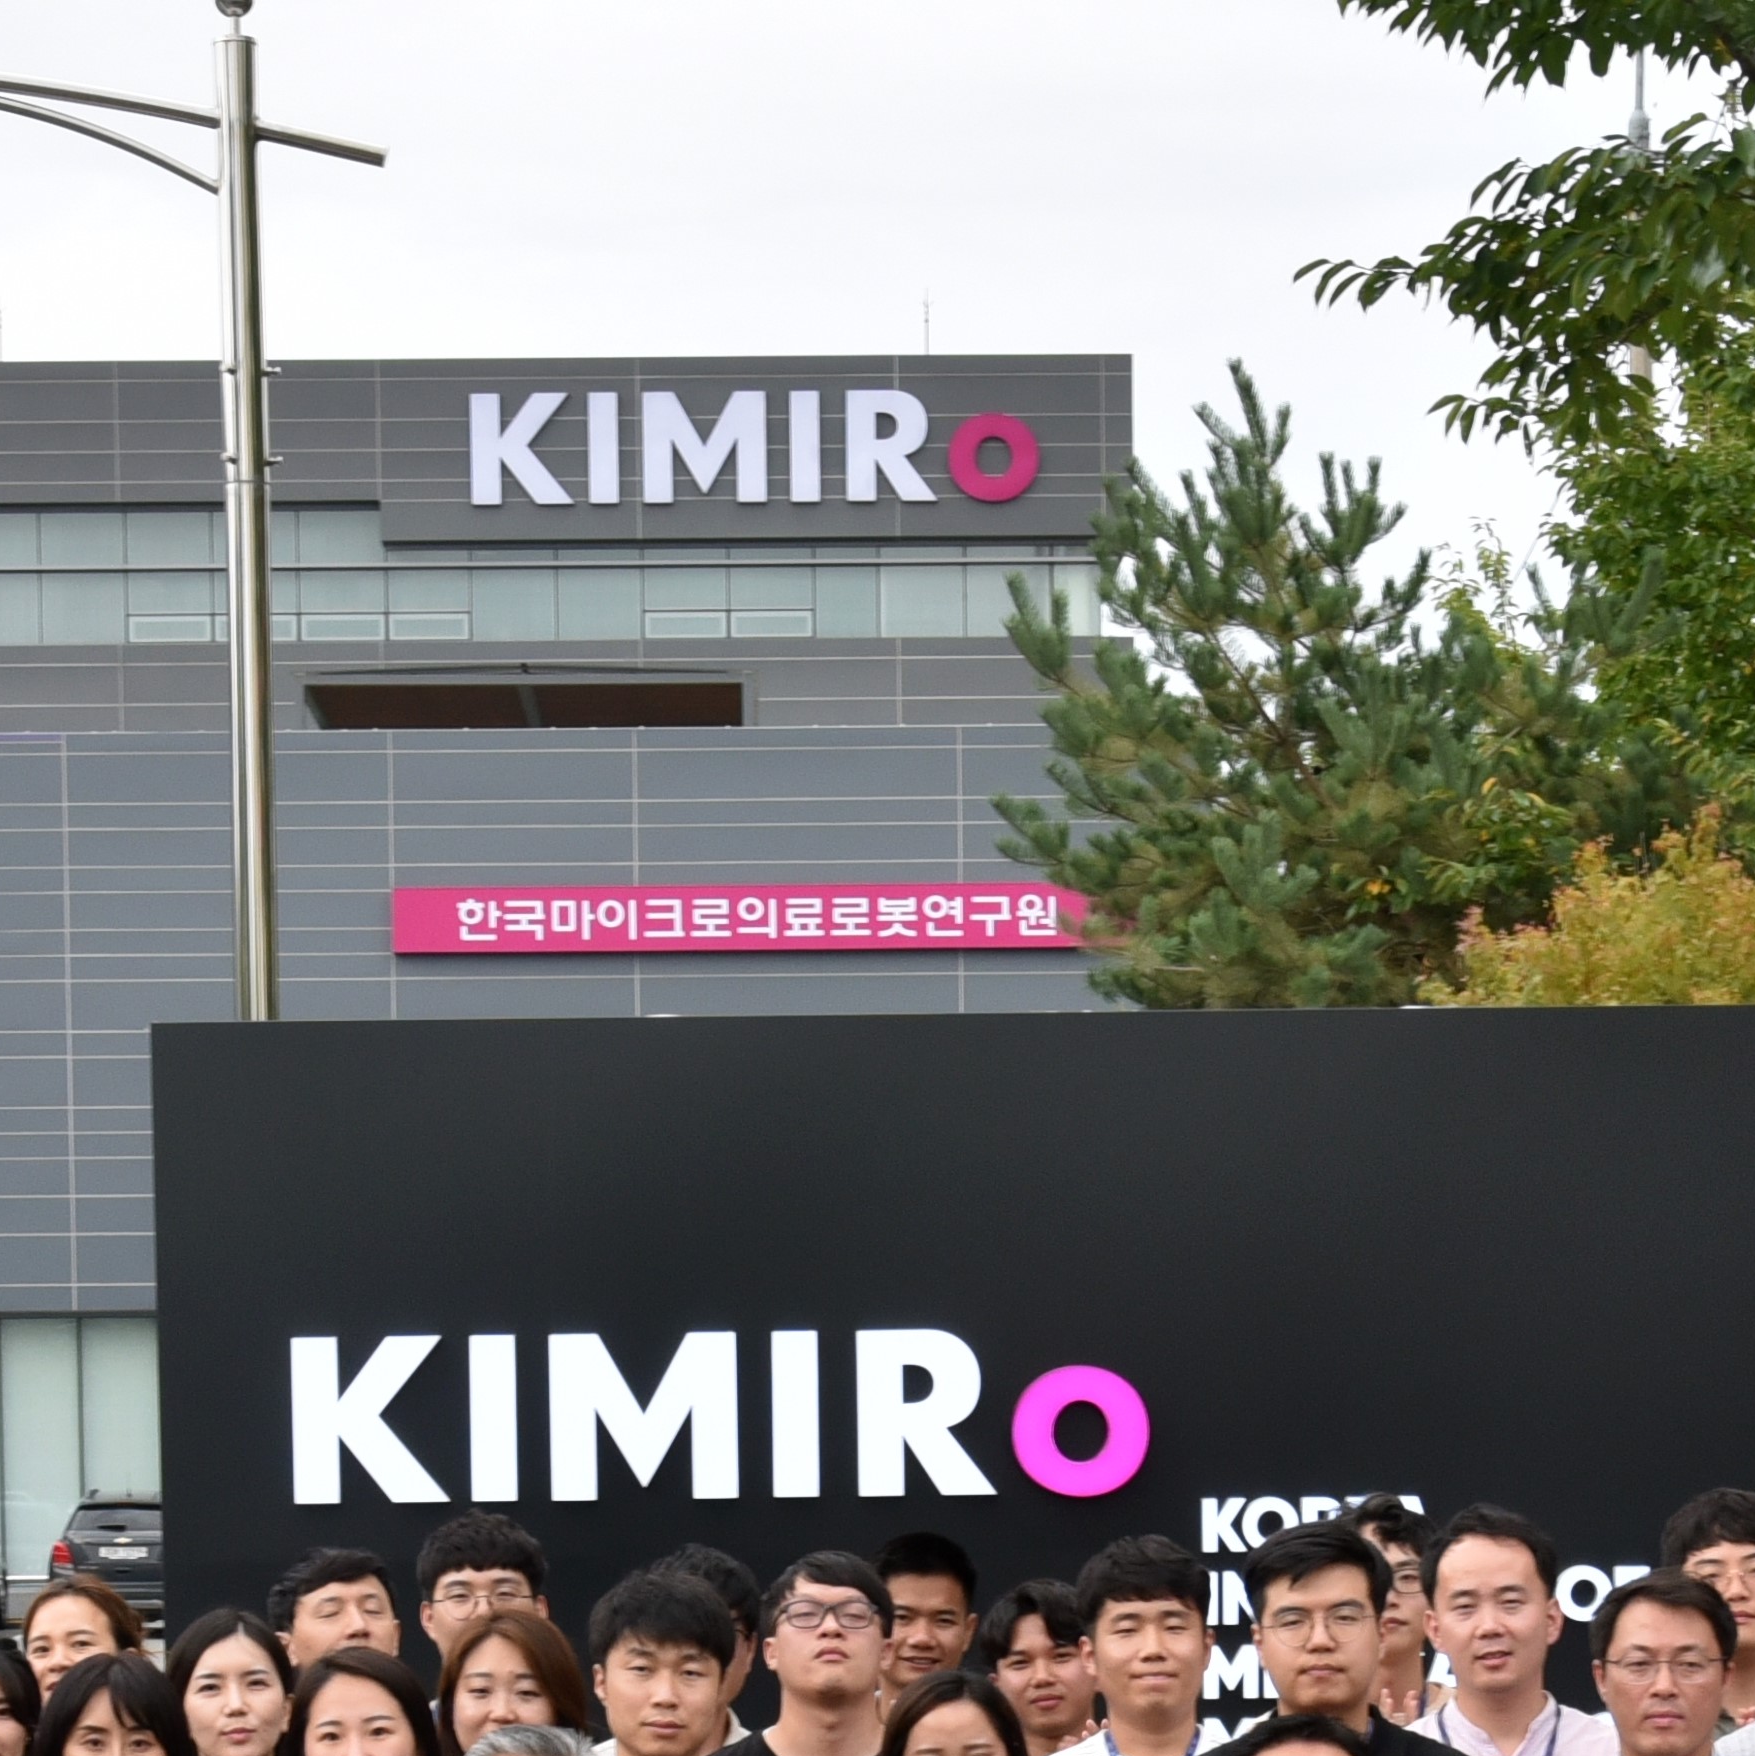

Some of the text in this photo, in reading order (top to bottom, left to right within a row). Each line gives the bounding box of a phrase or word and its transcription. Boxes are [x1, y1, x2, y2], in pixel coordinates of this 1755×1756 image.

[468, 389, 1041, 506] KIMIRo
[456, 893, 1058, 942] 한국마이크로의료로봇연구원
[289, 1327, 1153, 1505] KIMIRo
